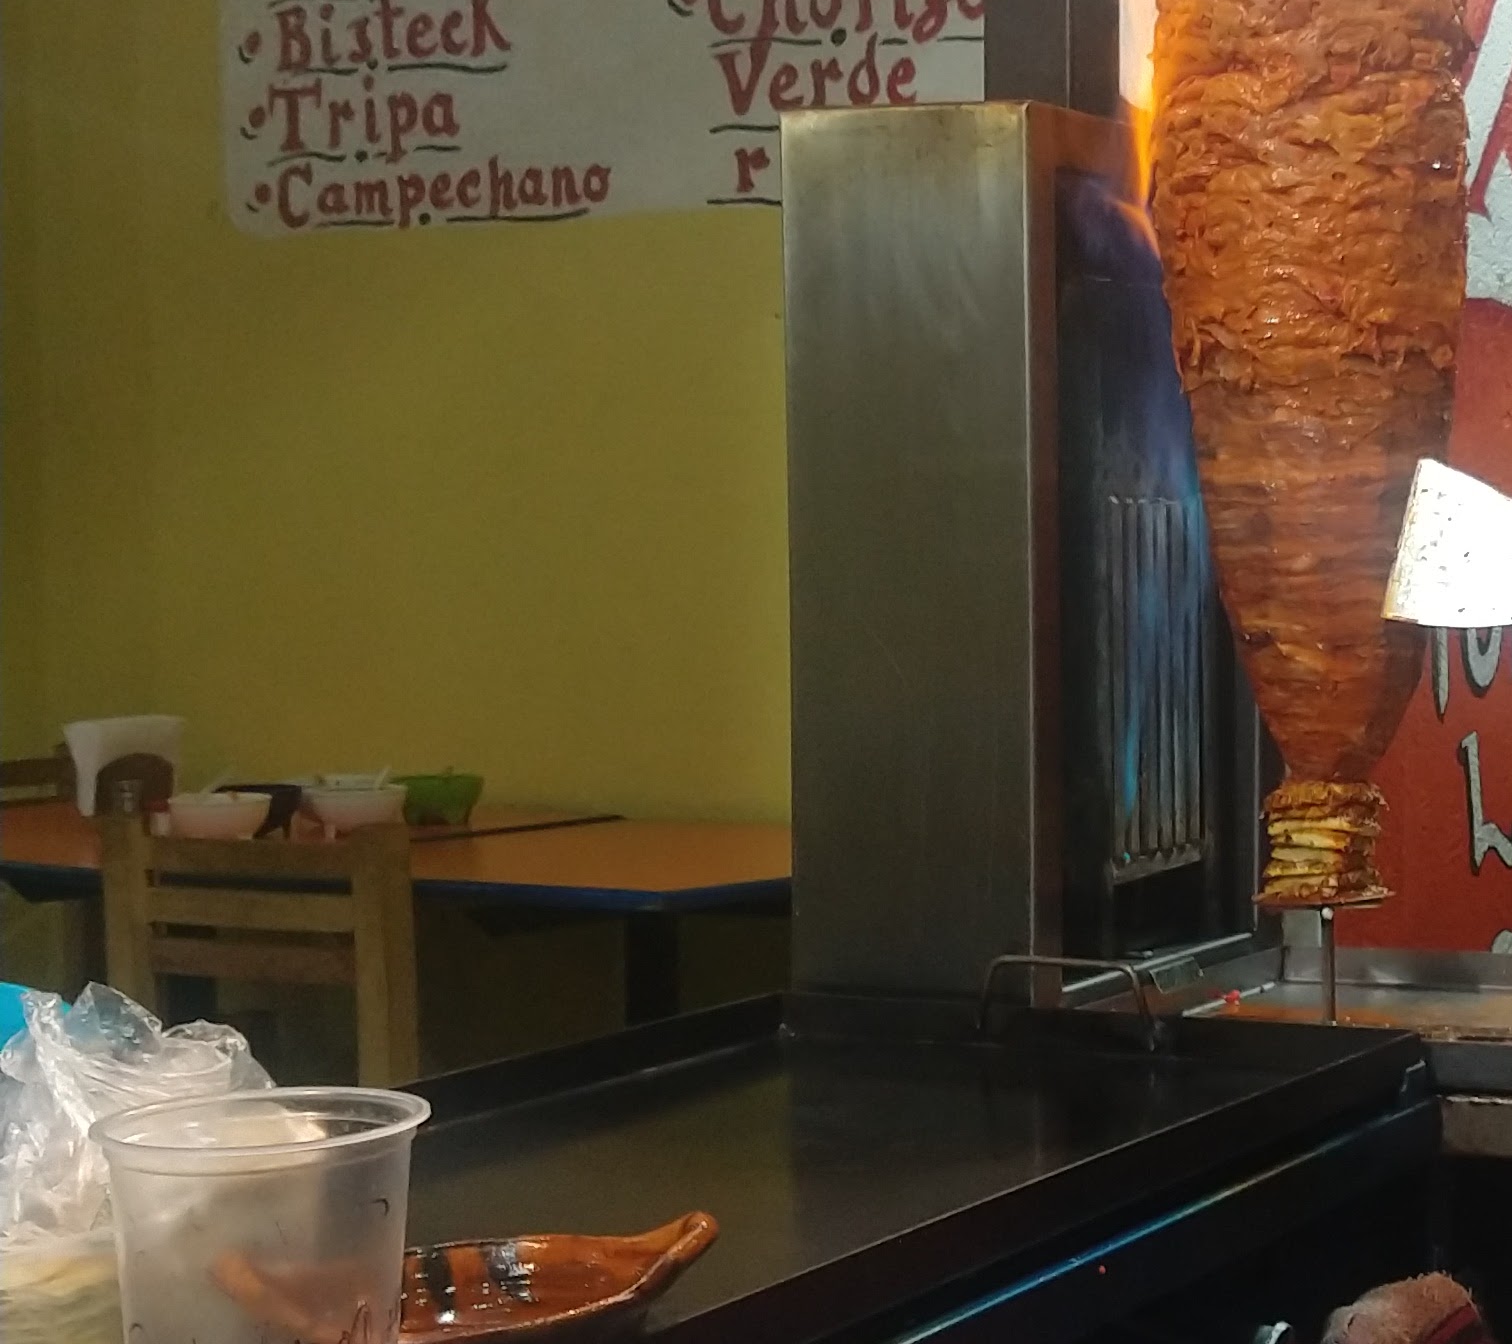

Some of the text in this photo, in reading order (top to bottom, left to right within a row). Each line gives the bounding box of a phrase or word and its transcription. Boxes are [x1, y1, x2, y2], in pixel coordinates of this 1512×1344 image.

[718, 33, 917, 115] Verde
[269, 75, 460, 163] Tripa
[277, 156, 611, 228] Campechano
